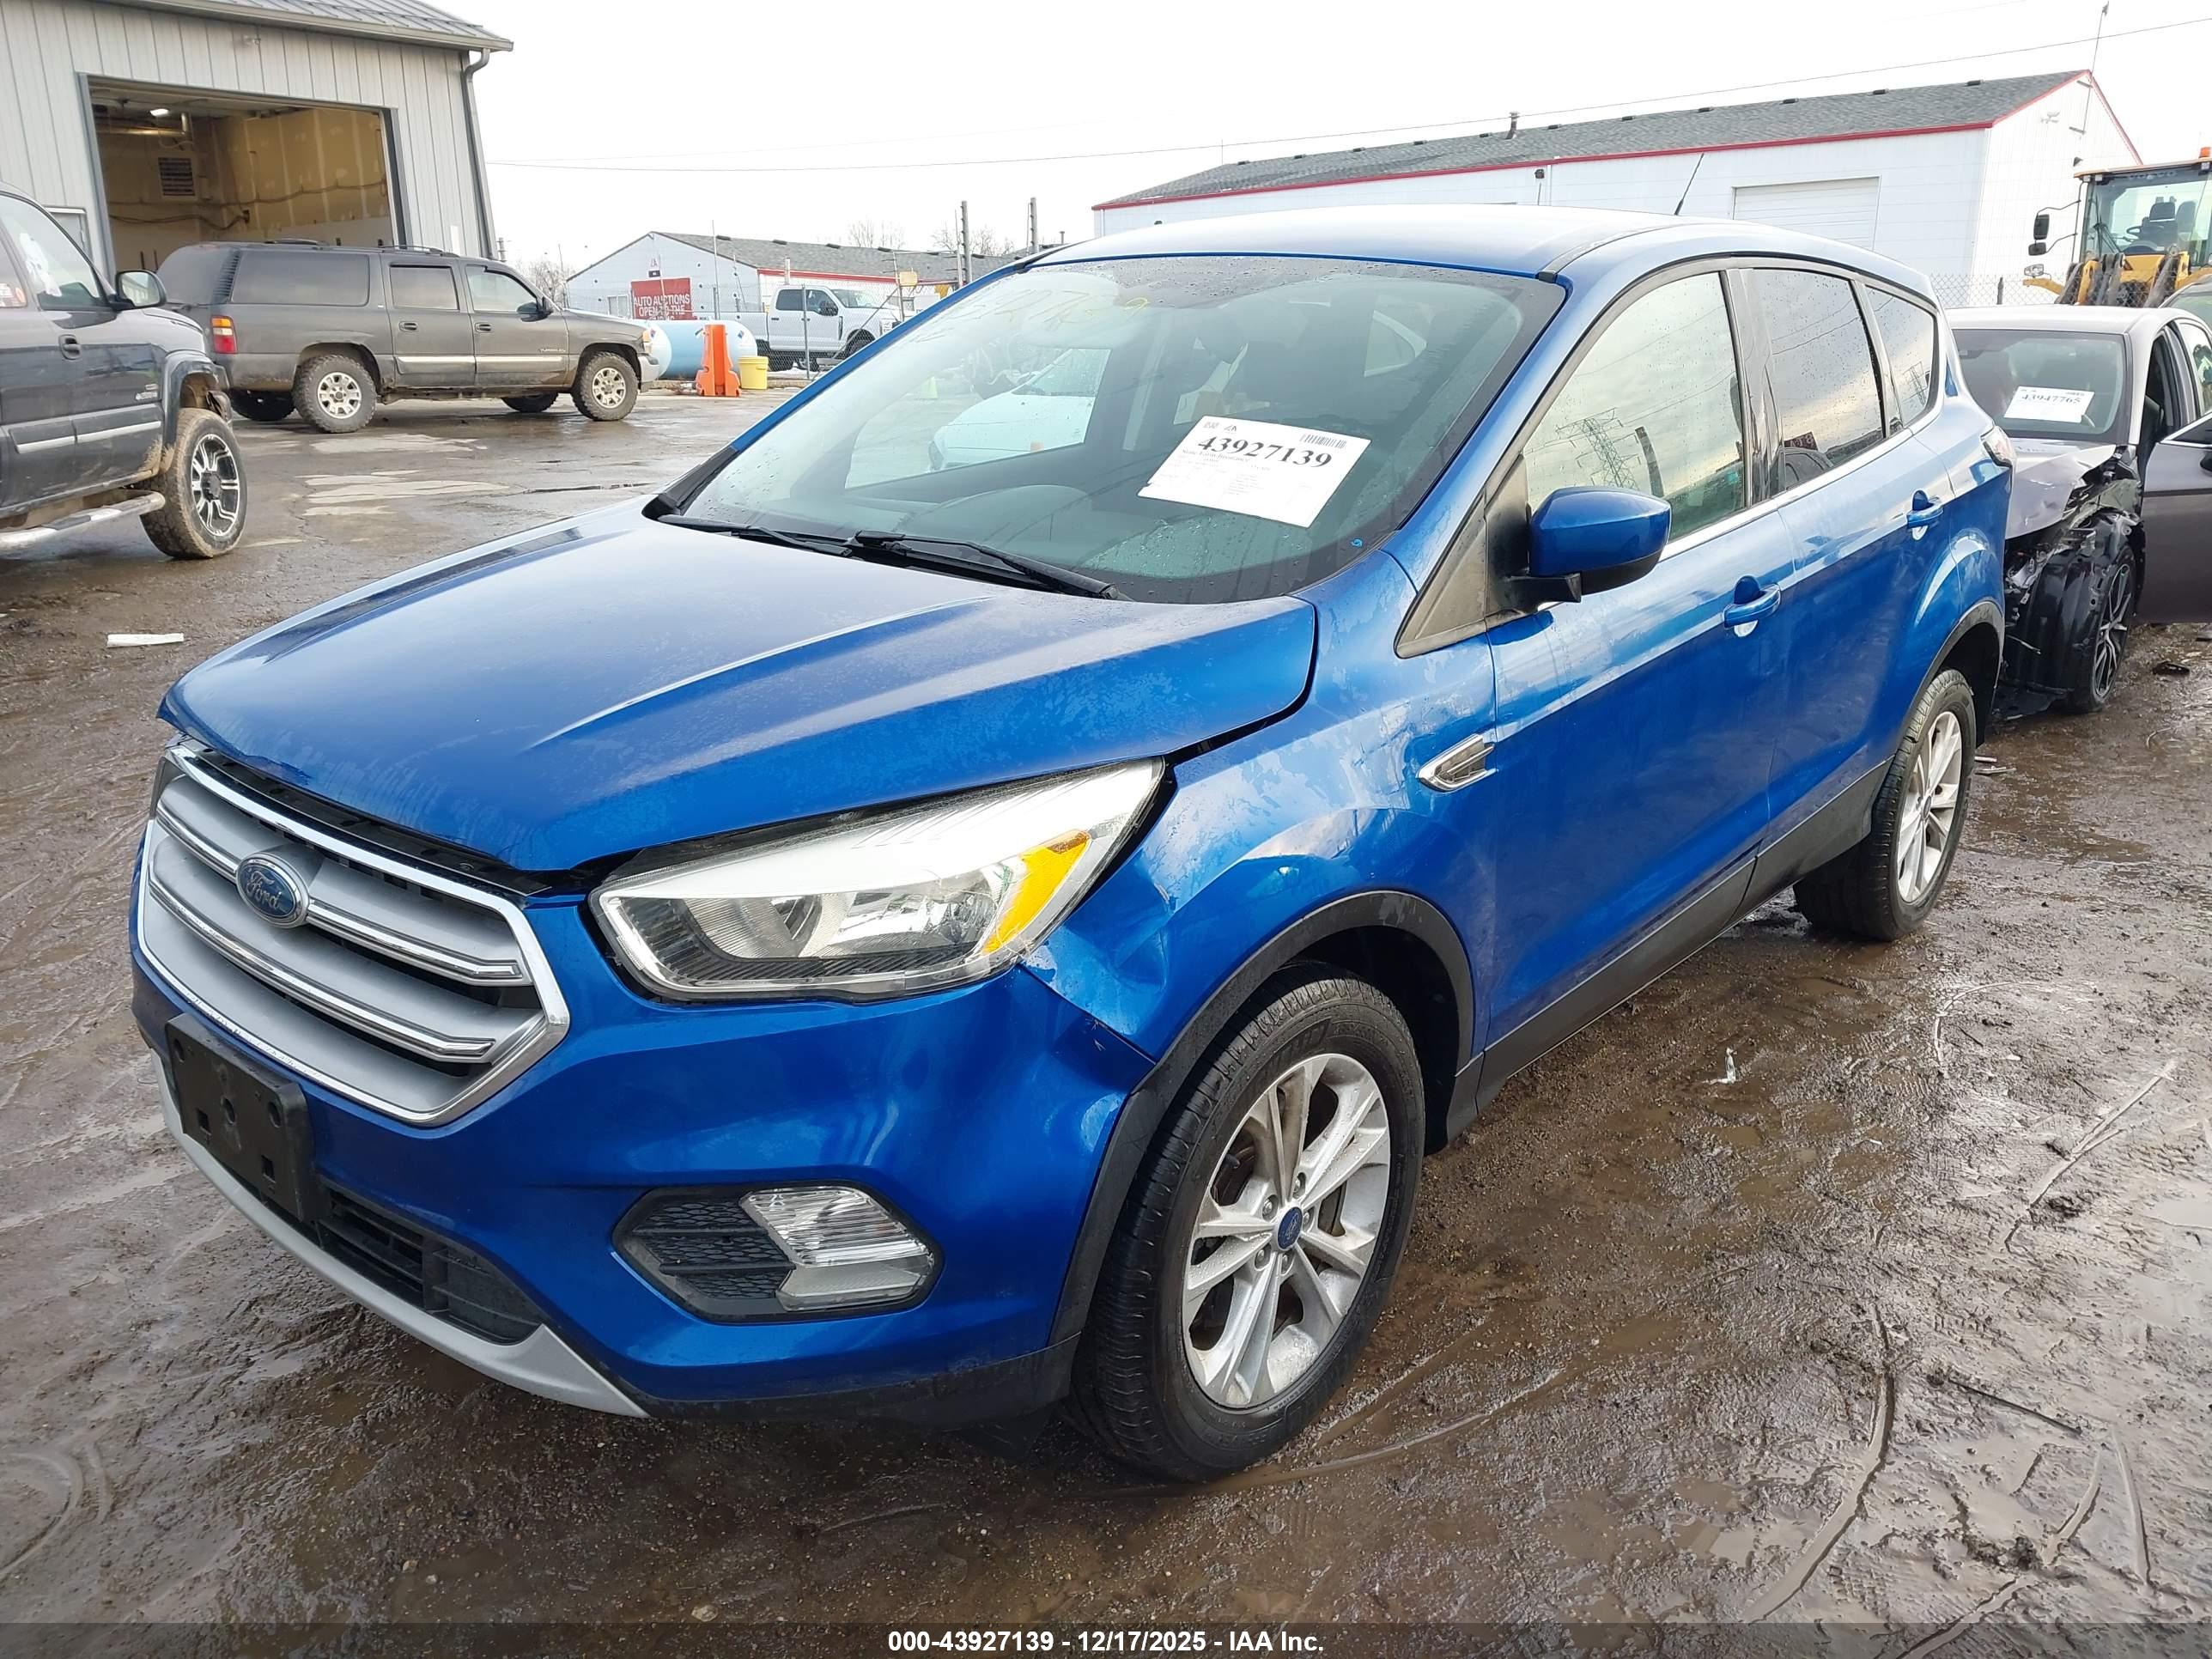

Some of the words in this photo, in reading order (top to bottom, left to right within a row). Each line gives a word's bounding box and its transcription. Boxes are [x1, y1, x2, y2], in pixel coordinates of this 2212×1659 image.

[634, 295, 653, 307] AUTO
[653, 294, 690, 306] AUCTIONS
[639, 307, 659, 317] OPEN
[671, 305, 685, 315] THE
[1198, 436, 1332, 467] 43927139
[246, 871, 283, 909] Ford
